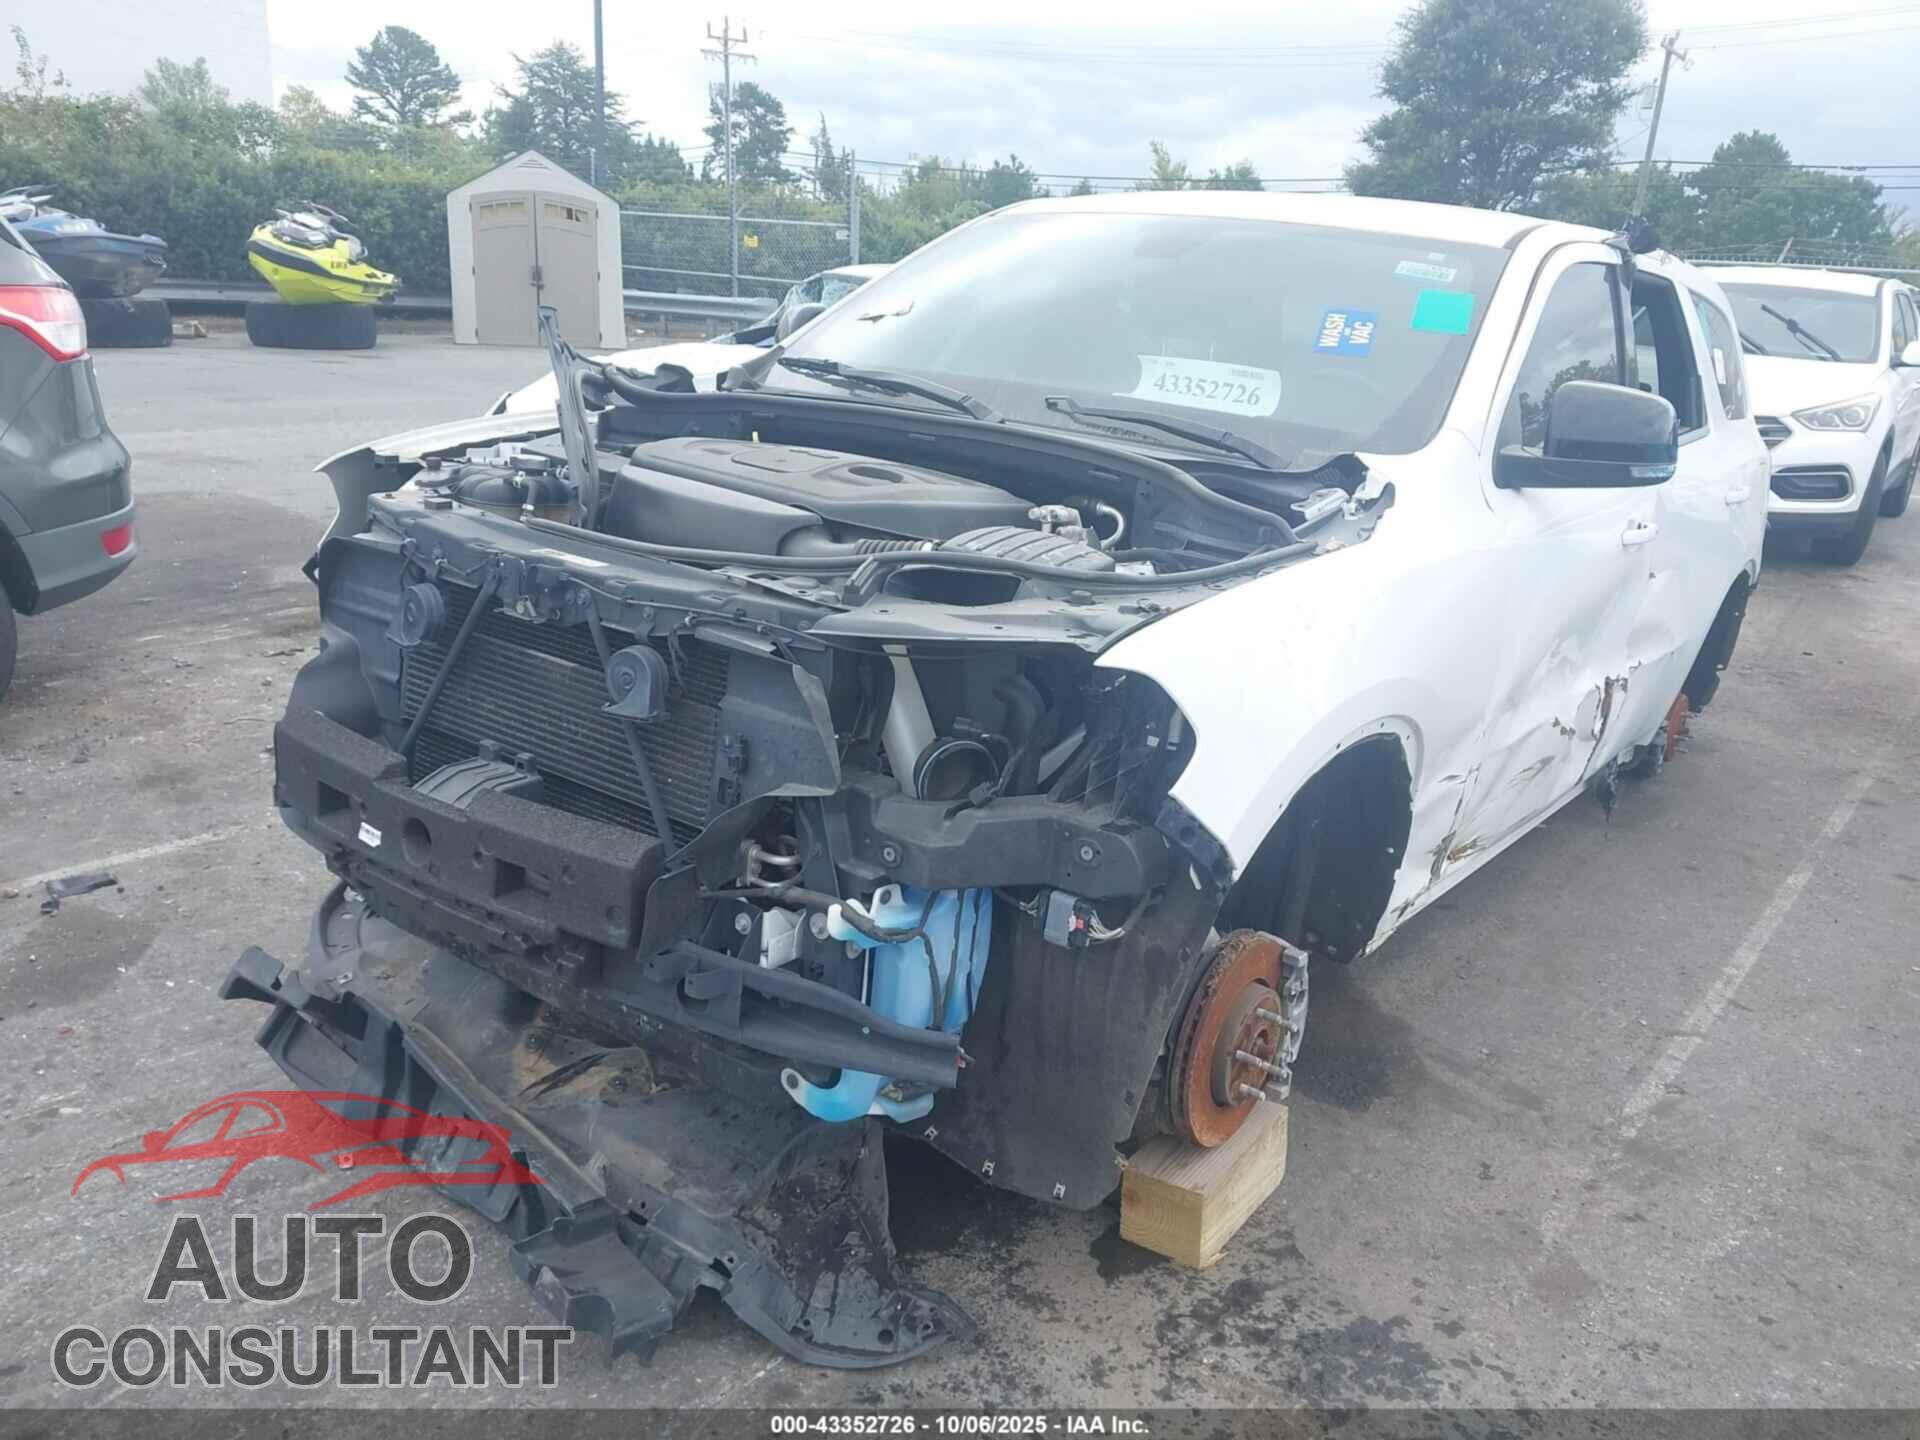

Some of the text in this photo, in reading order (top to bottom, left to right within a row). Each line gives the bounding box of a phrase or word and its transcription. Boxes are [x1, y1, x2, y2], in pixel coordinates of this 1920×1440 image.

[1318, 313, 1346, 347] WASH
[1349, 321, 1374, 344] VAC
[1153, 372, 1262, 406] 43352726
